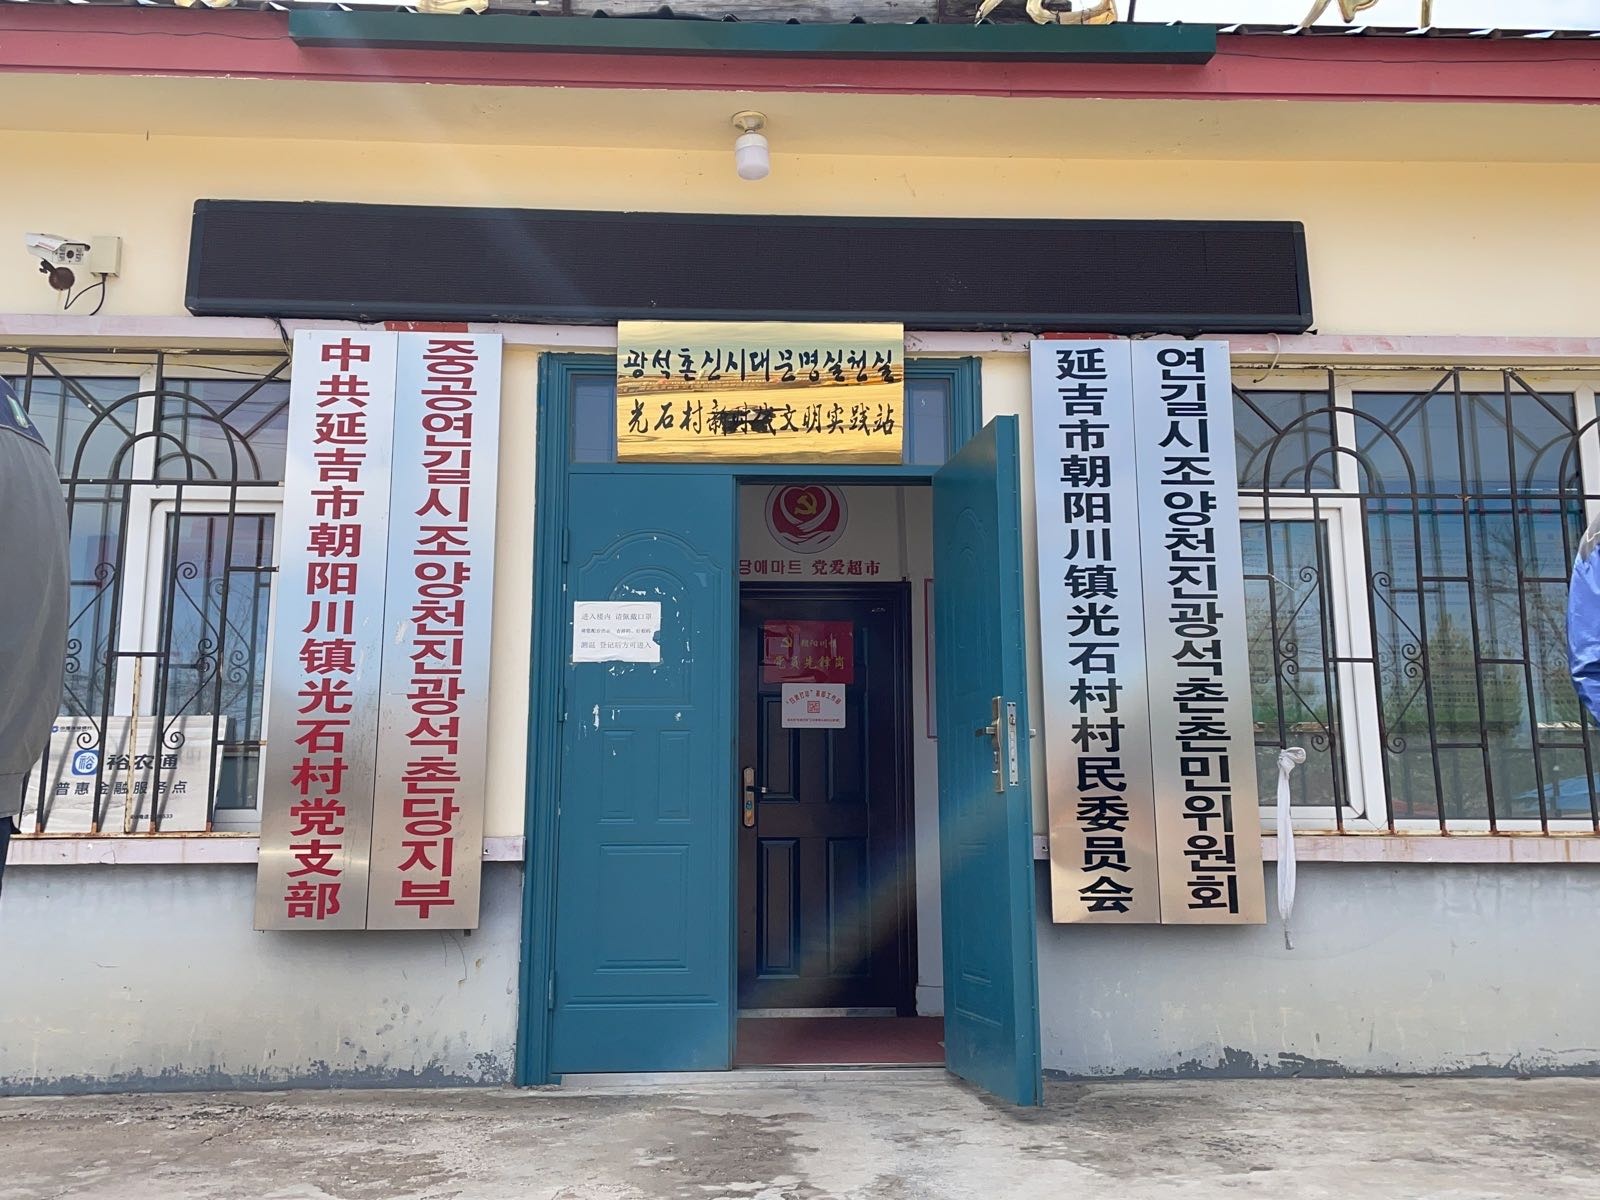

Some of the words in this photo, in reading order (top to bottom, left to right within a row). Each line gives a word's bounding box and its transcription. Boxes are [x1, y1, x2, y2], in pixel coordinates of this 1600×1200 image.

[284, 337, 371, 920] 中共延吉市朝阳川镇光石村党支部
[394, 339, 478, 919] 중공연길시조양천진광석촌당지부
[623, 347, 894, 383] 광석촌신시대문명실천실
[811, 559, 881, 575] 党爱超市
[1055, 347, 1134, 914] 延吉市朝阳川镇光石村村民委员会
[1156, 347, 1239, 914] 연길시조양천진광석촌촌민위원회
